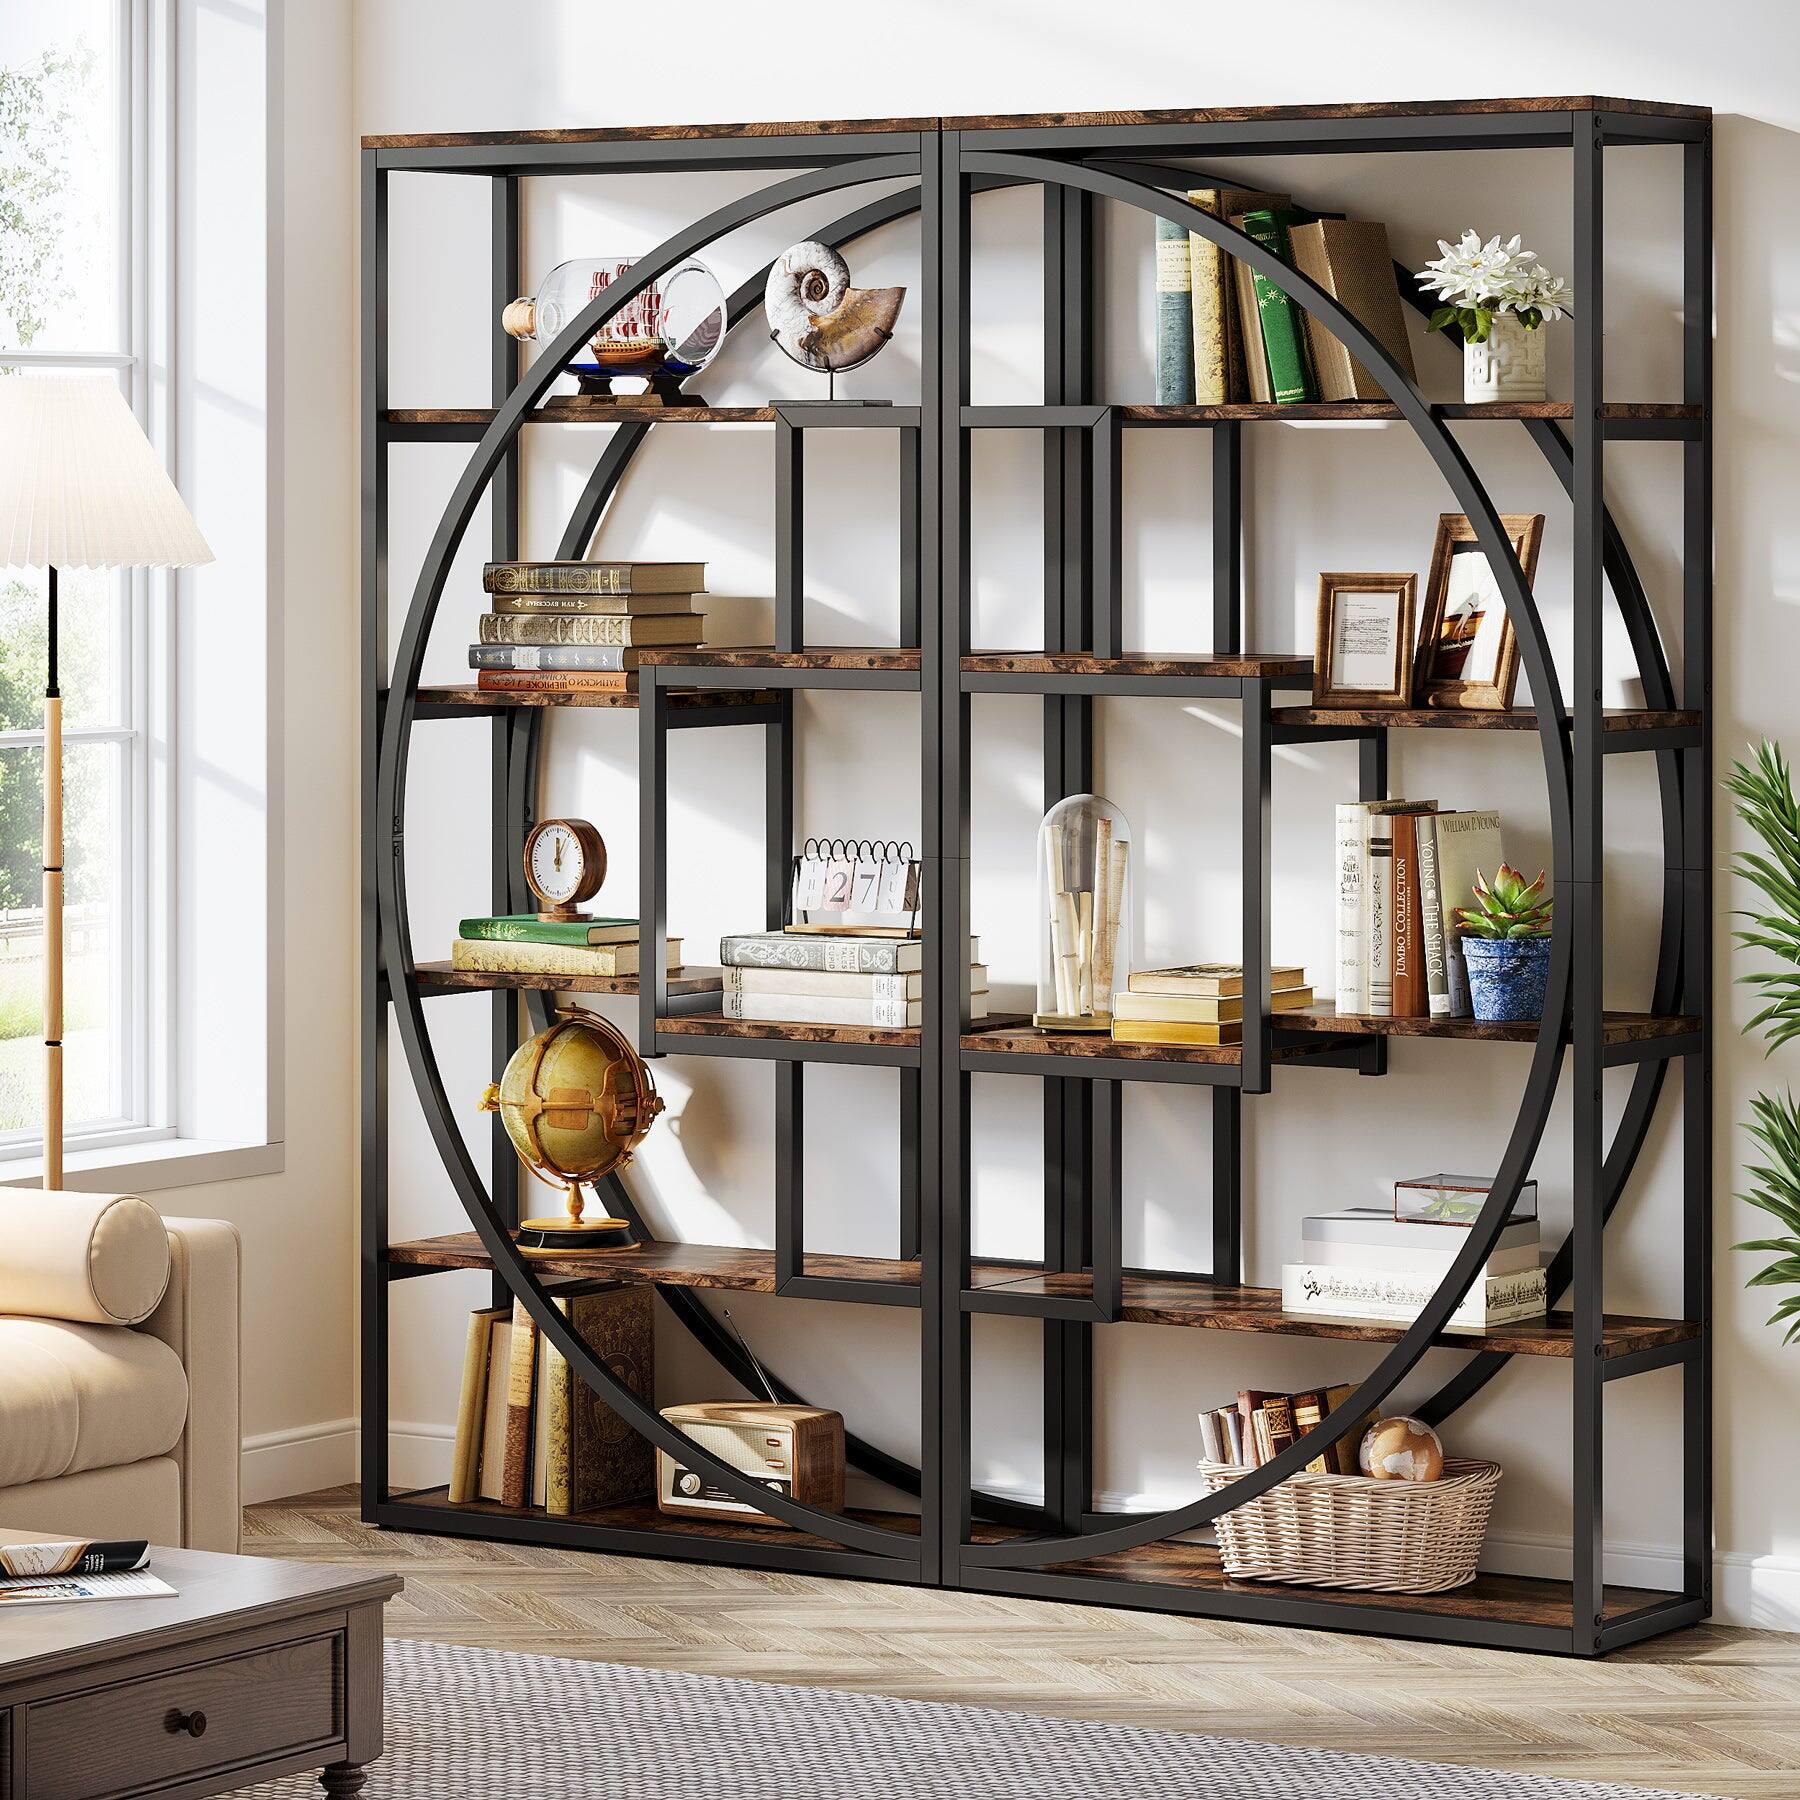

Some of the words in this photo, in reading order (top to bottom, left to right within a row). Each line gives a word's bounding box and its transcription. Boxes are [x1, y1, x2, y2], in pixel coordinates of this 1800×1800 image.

[1442, 819, 1470, 833] WILLIAM
[1476, 816, 1500, 830] YOUNG
[1421, 839, 1436, 889] YOUNG
[1395, 858, 1406, 933] COLLECTION
[1424, 902, 1440, 930] THE
[828, 945, 836, 970] CUPID
[1395, 936, 1409, 978] JUMBO
[1426, 932, 1444, 977] SHACK
